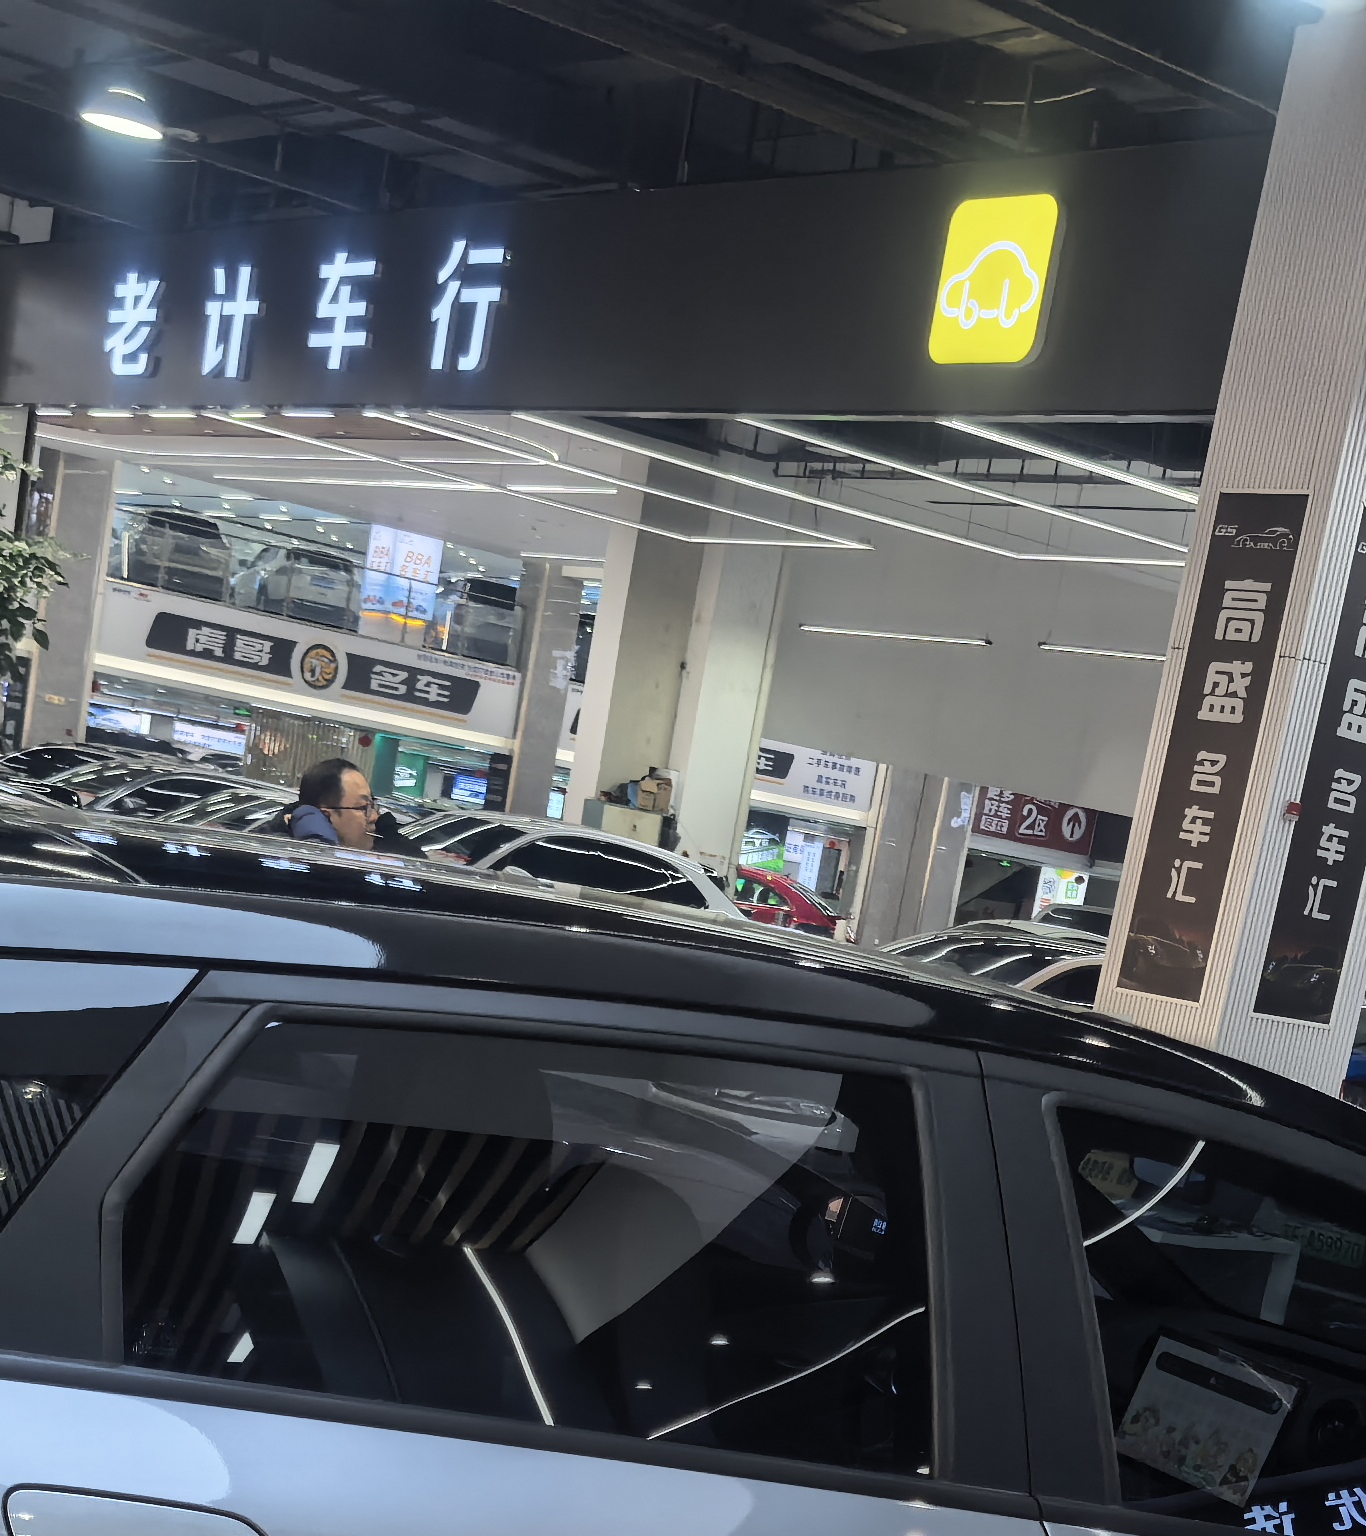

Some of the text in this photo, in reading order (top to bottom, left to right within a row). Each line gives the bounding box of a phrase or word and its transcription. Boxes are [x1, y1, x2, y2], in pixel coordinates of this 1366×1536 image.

[104, 238, 507, 378] 老计车行
[185, 626, 276, 667] 虎哥
[369, 664, 452, 704] 名车
[1166, 578, 1273, 904] 高盛名车汇
